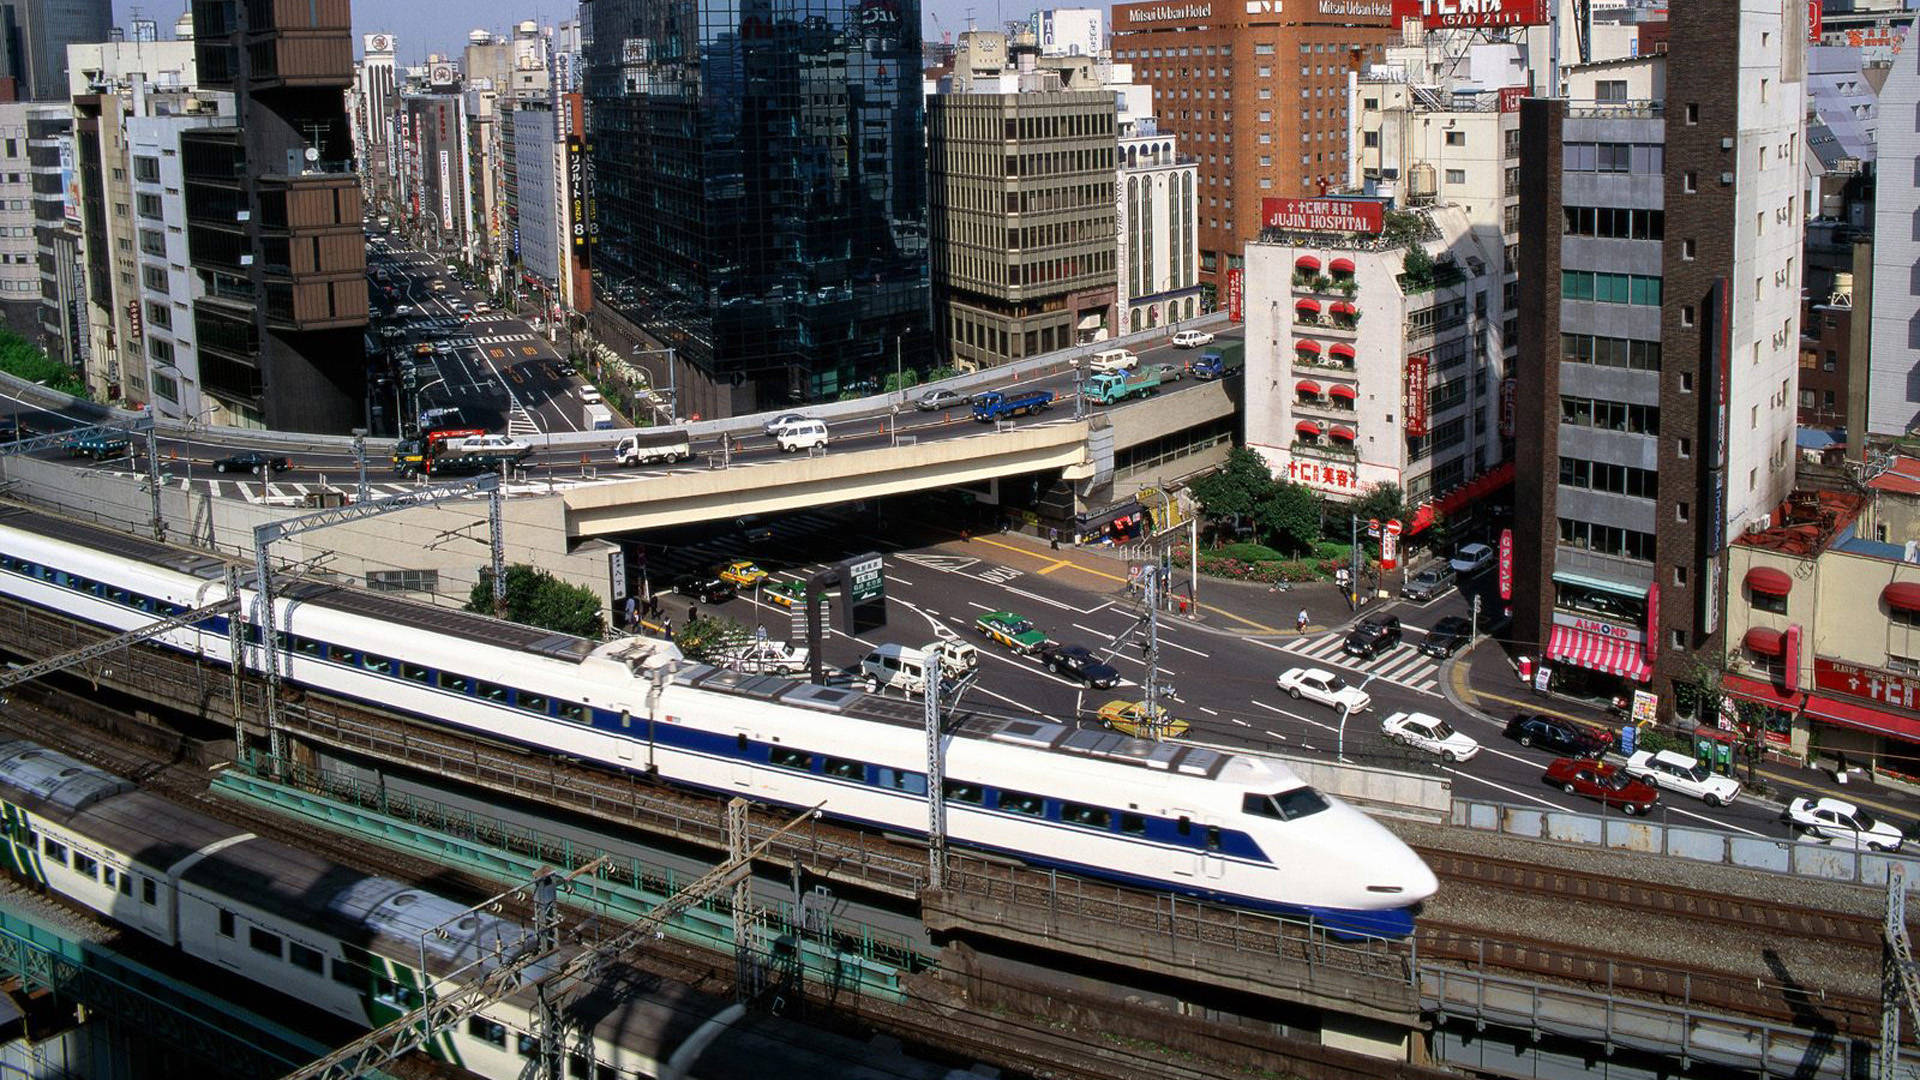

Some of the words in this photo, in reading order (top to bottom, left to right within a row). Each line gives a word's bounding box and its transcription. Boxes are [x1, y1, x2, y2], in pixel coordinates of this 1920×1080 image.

[1129, 8, 1156, 23] Mitsui
[1157, 5, 1184, 21] Urban
[1186, 2, 1212, 18] Hotel
[1319, 0, 1345, 14] Mitsui
[1346, 0, 1371, 15] Urban
[1442, 14, 1477, 25] (571)
[1483, 13, 1521, 25] 2111
[571, 154, 582, 198] リクルート
[574, 223, 584, 236] 8
[1270, 213, 1306, 228] JUJIN
[1310, 214, 1371, 231] HOSPITAL
[1575, 618, 1629, 638] ALMOND
